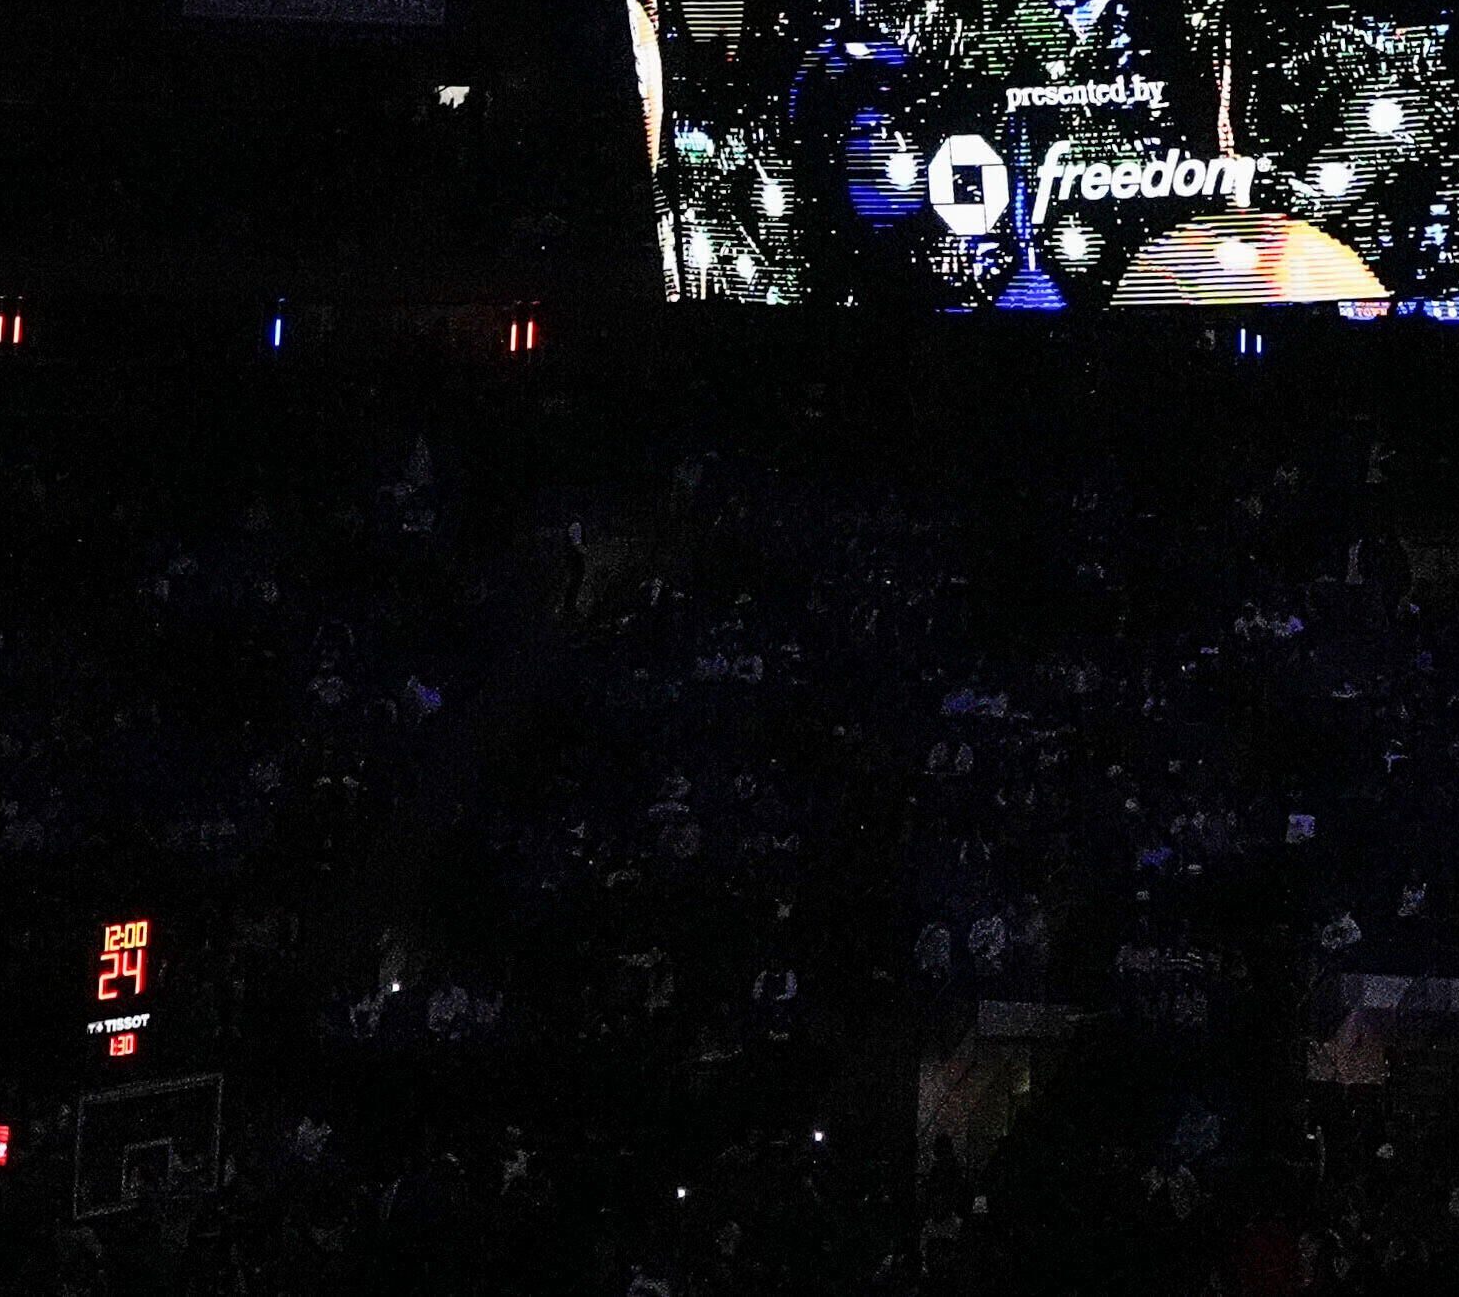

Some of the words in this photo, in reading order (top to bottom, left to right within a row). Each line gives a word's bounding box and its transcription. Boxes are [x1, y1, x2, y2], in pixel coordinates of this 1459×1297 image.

[1006, 75, 1127, 113] presented
[1132, 73, 1170, 109] by
[1031, 140, 1257, 224] freedom
[104, 921, 148, 952] 12:00
[98, 948, 143, 1000] 24
[104, 1013, 150, 1033] TISSOT
[109, 1033, 136, 1056] 1:30
